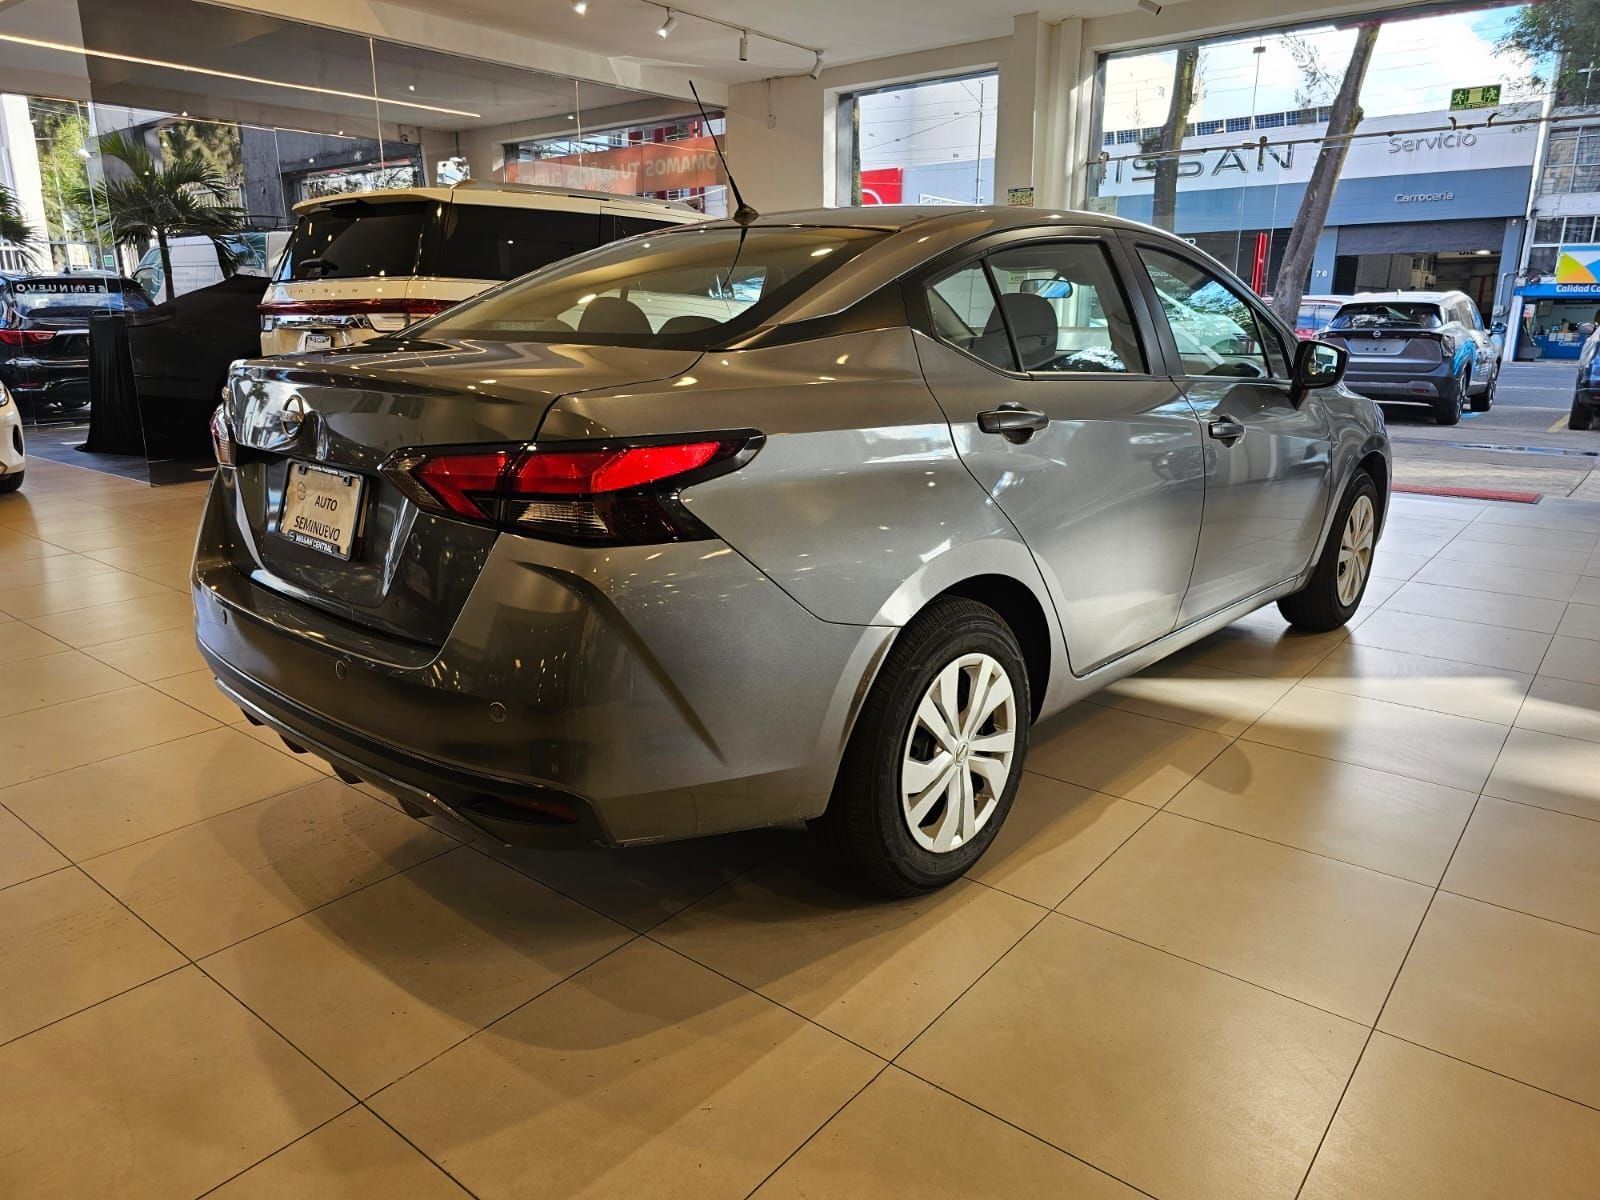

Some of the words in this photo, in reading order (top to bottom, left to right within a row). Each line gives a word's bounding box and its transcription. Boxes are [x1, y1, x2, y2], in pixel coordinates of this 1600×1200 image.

[1388, 131, 1477, 153] Servicio
[1556, 285, 1590, 293] Calidad
[314, 496, 338, 512] AUTO
[294, 515, 341, 541] SEMINUEVO
